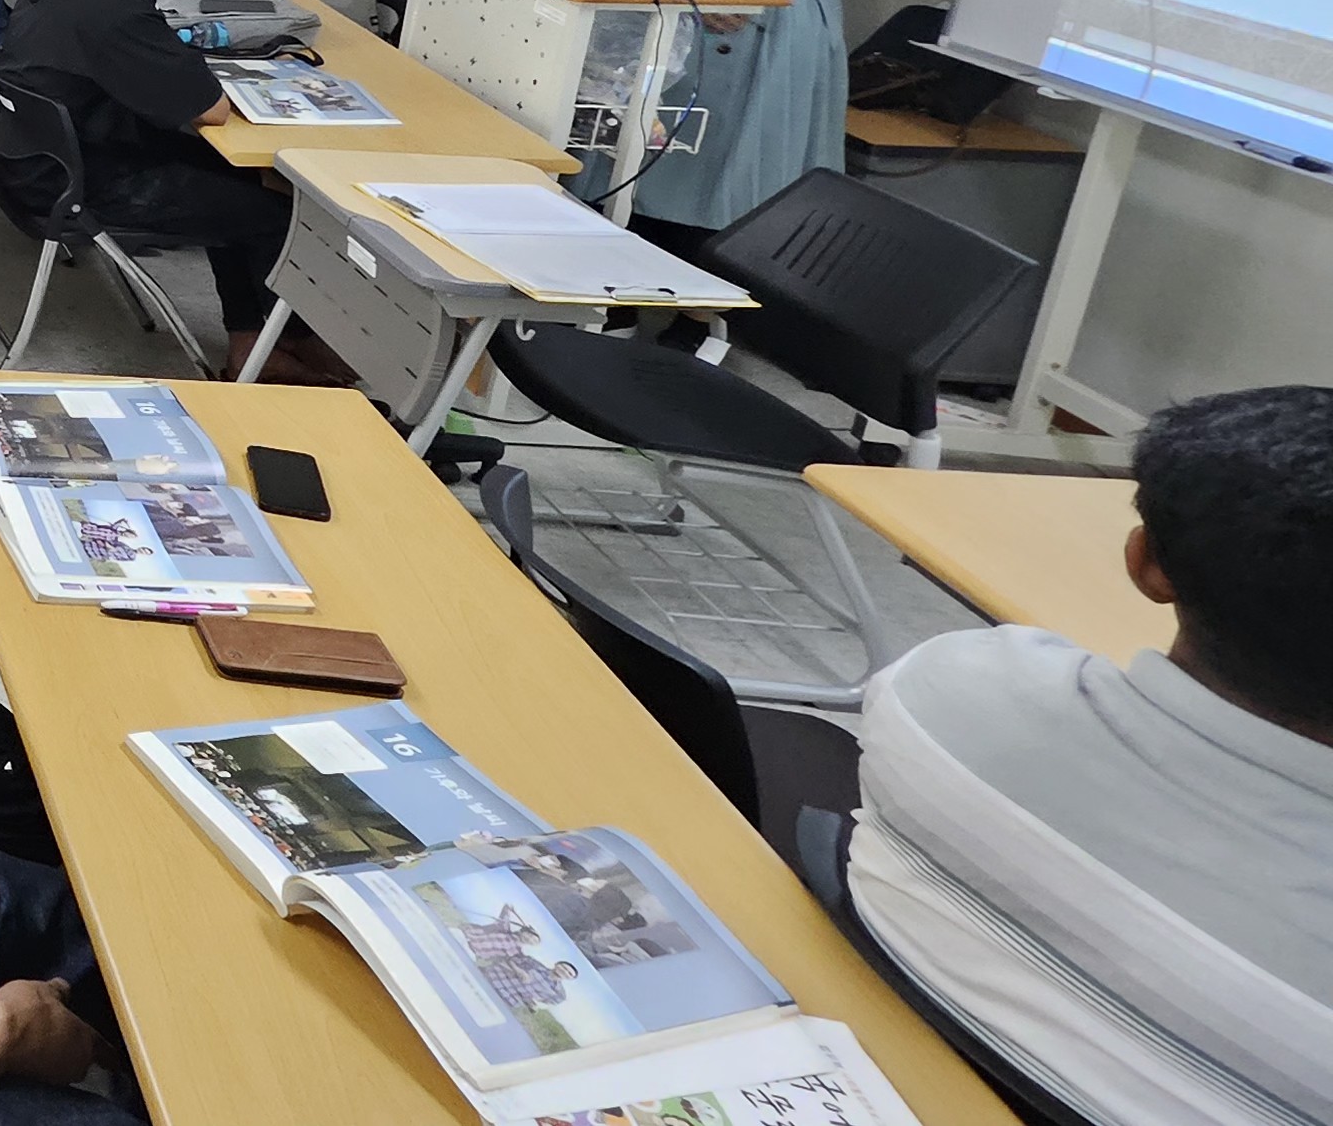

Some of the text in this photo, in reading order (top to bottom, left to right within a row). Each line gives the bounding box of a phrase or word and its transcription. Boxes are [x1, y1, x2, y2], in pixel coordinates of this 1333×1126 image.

[135, 401, 161, 414] 16
[382, 733, 423, 756] 16
[424, 767, 507, 826] 기후와 날씨
